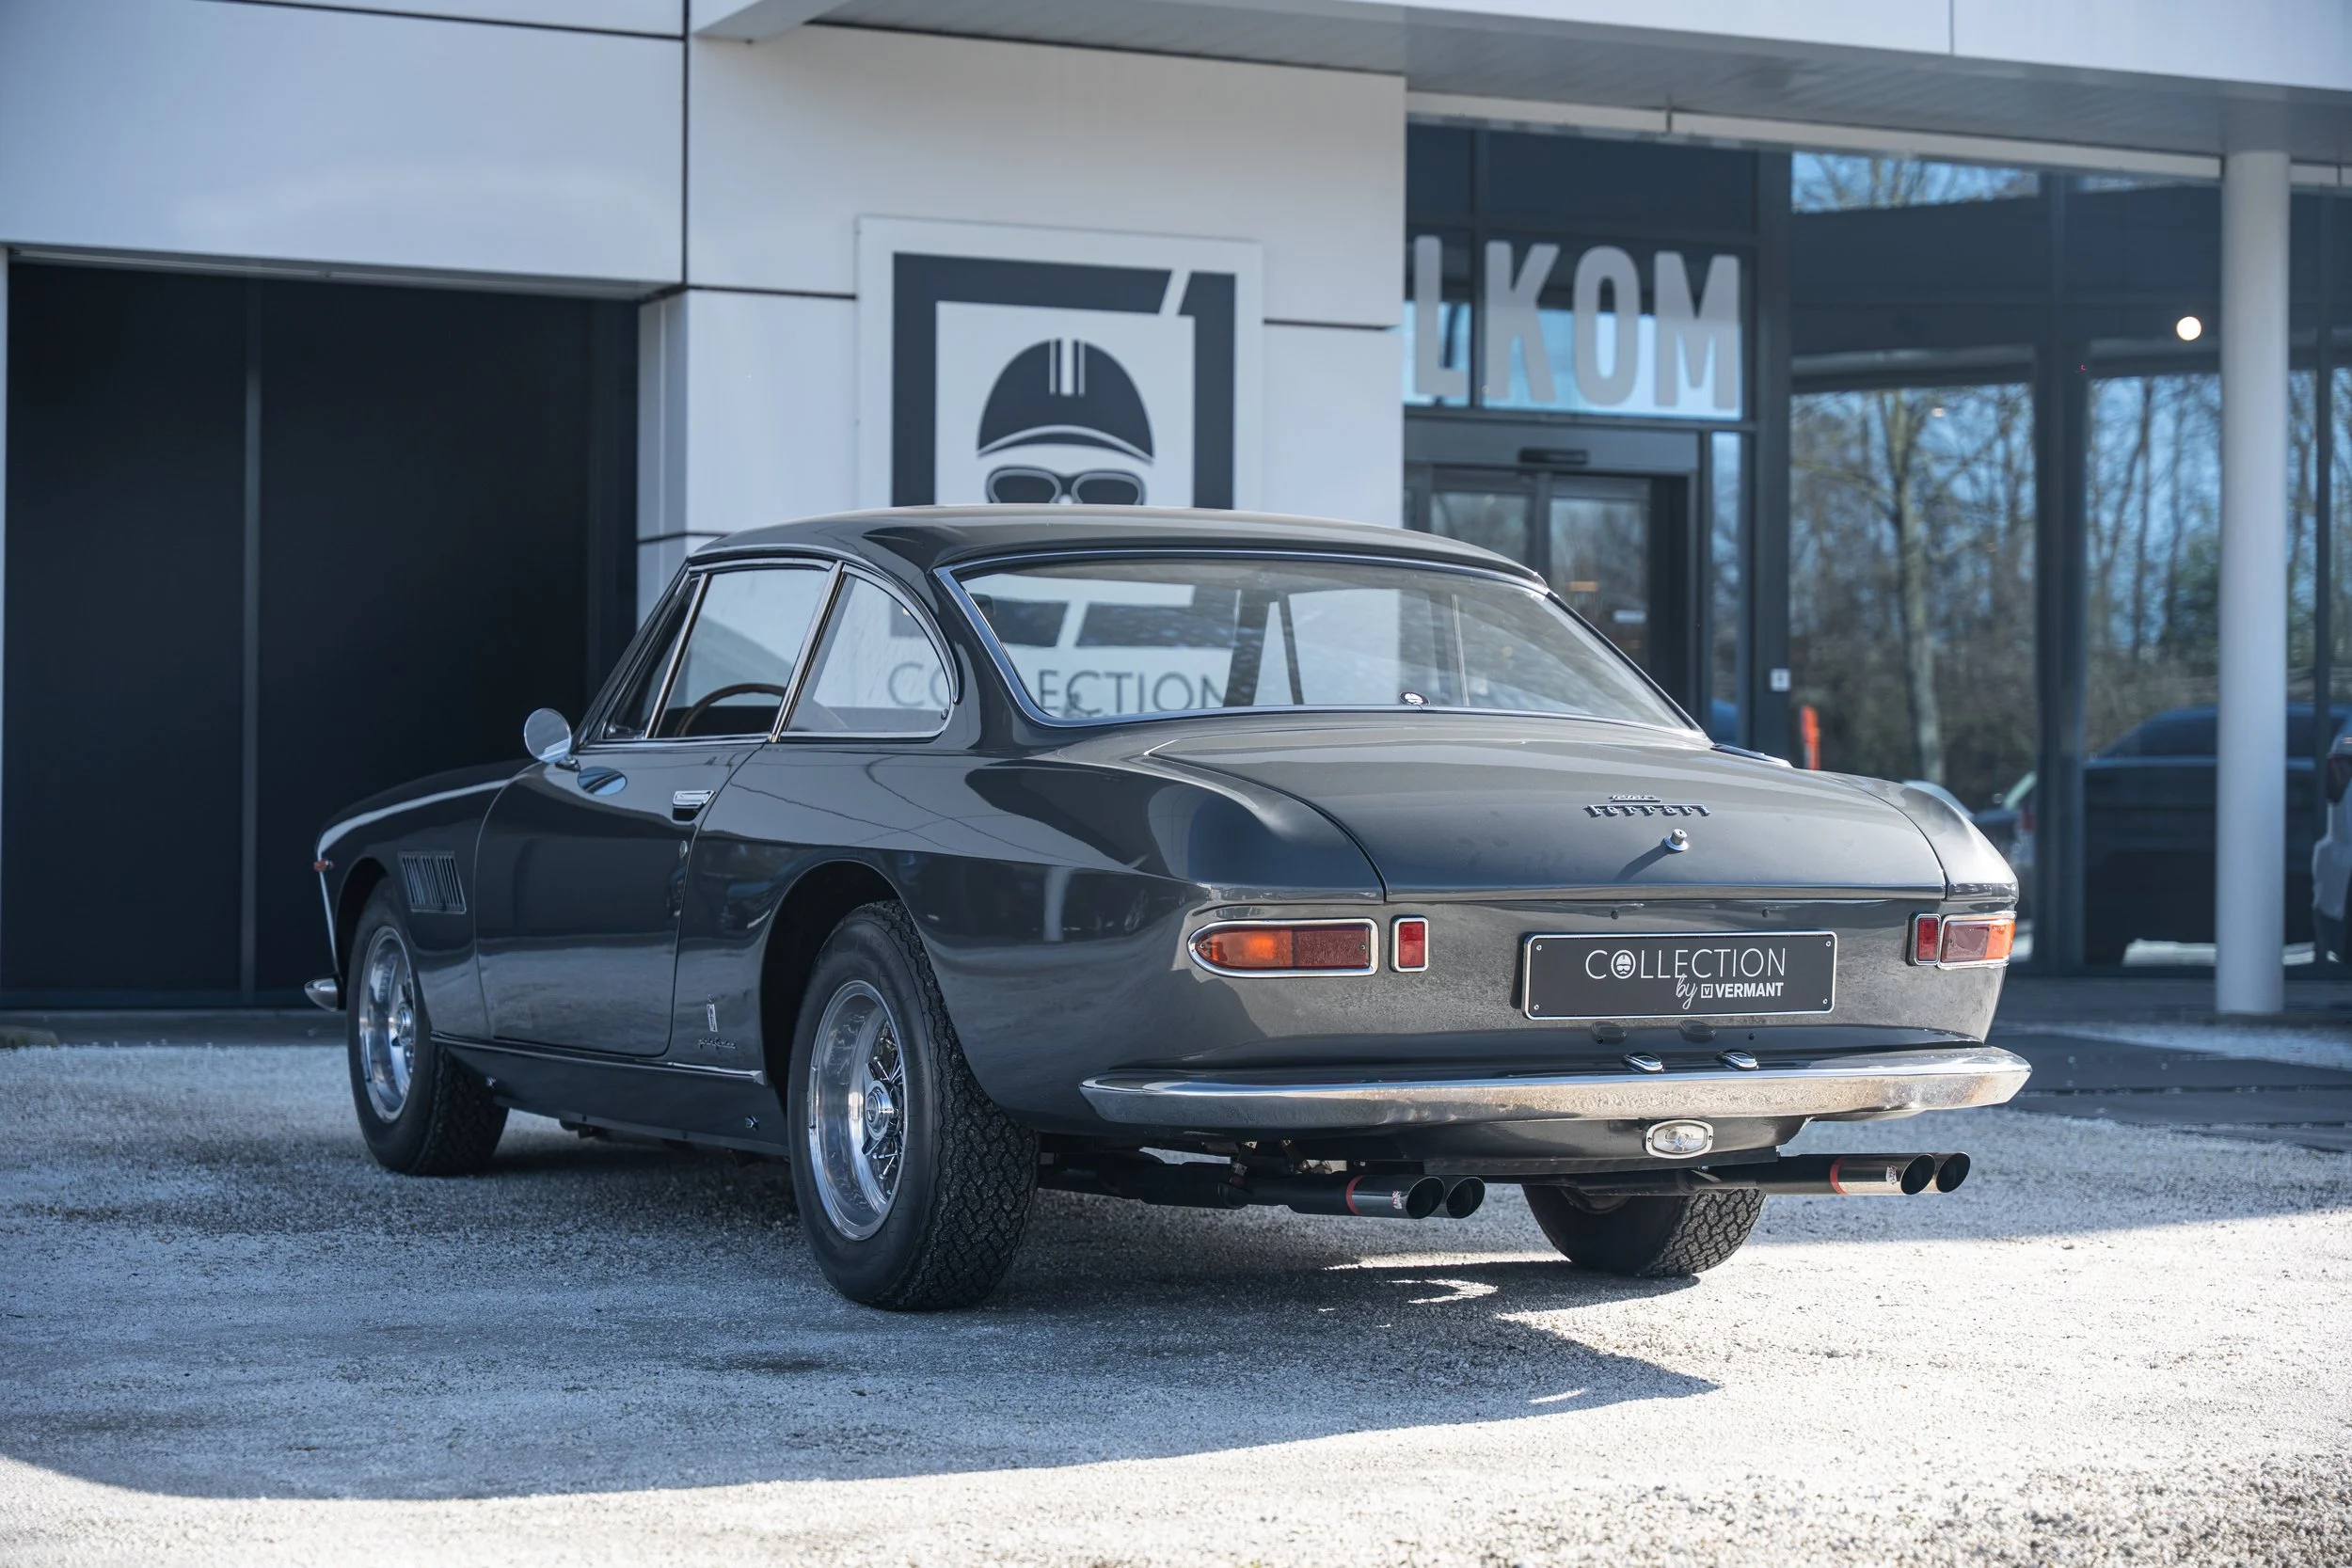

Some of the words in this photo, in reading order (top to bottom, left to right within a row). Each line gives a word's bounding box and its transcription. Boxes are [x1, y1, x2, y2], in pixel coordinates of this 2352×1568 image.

[1414, 235, 1740, 409] LKOM
[1585, 947, 1786, 979] COLLECTION
[1676, 974, 1698, 1009] by
[1715, 982, 1784, 998] VERMANT
